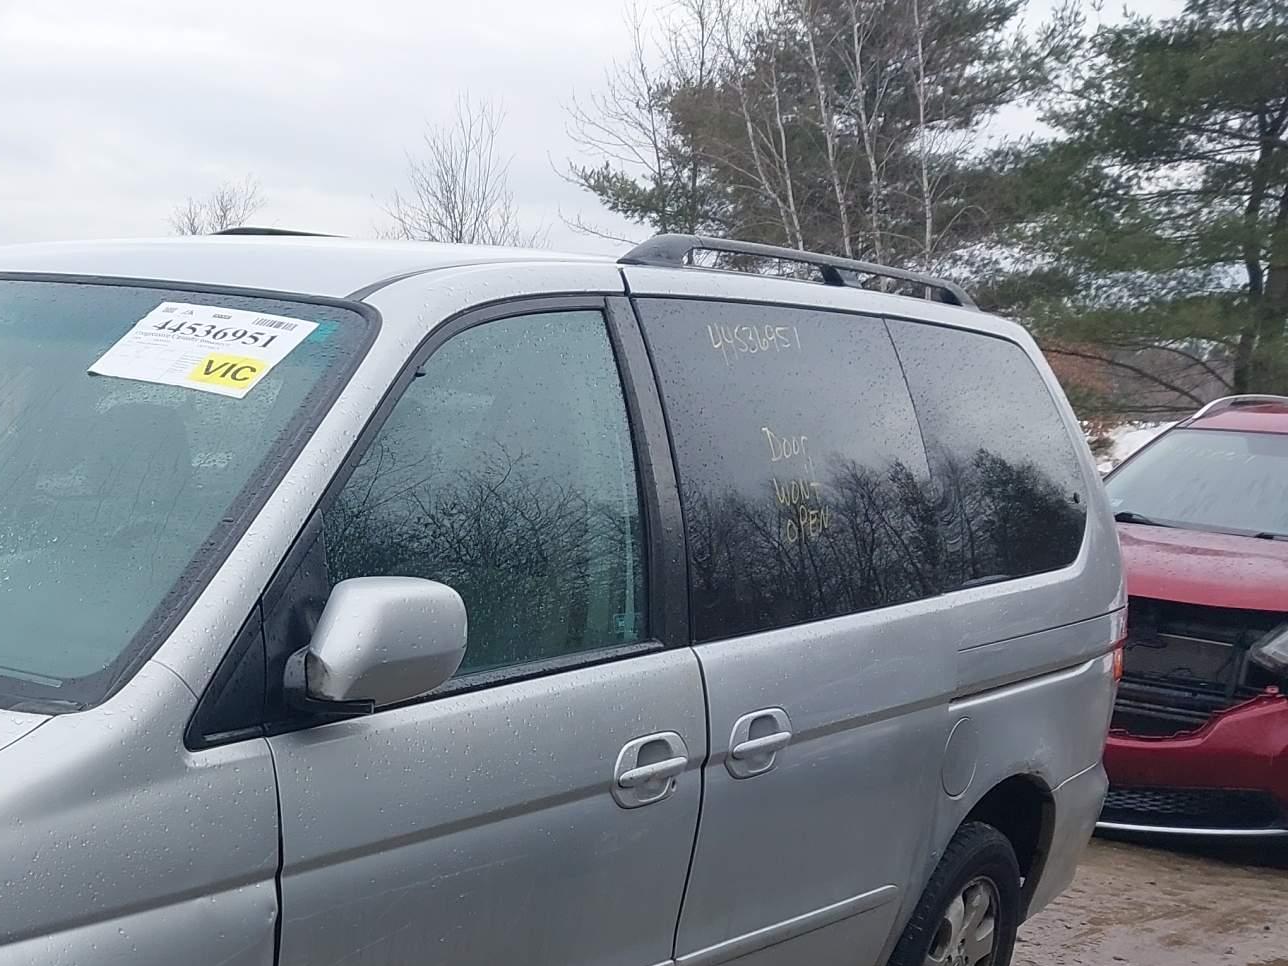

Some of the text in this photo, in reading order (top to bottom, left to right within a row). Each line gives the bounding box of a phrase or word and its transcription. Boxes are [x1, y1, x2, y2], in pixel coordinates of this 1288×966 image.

[153, 319, 278, 348] 44536951
[707, 323, 801, 366] 44536951
[203, 359, 257, 382] VIC
